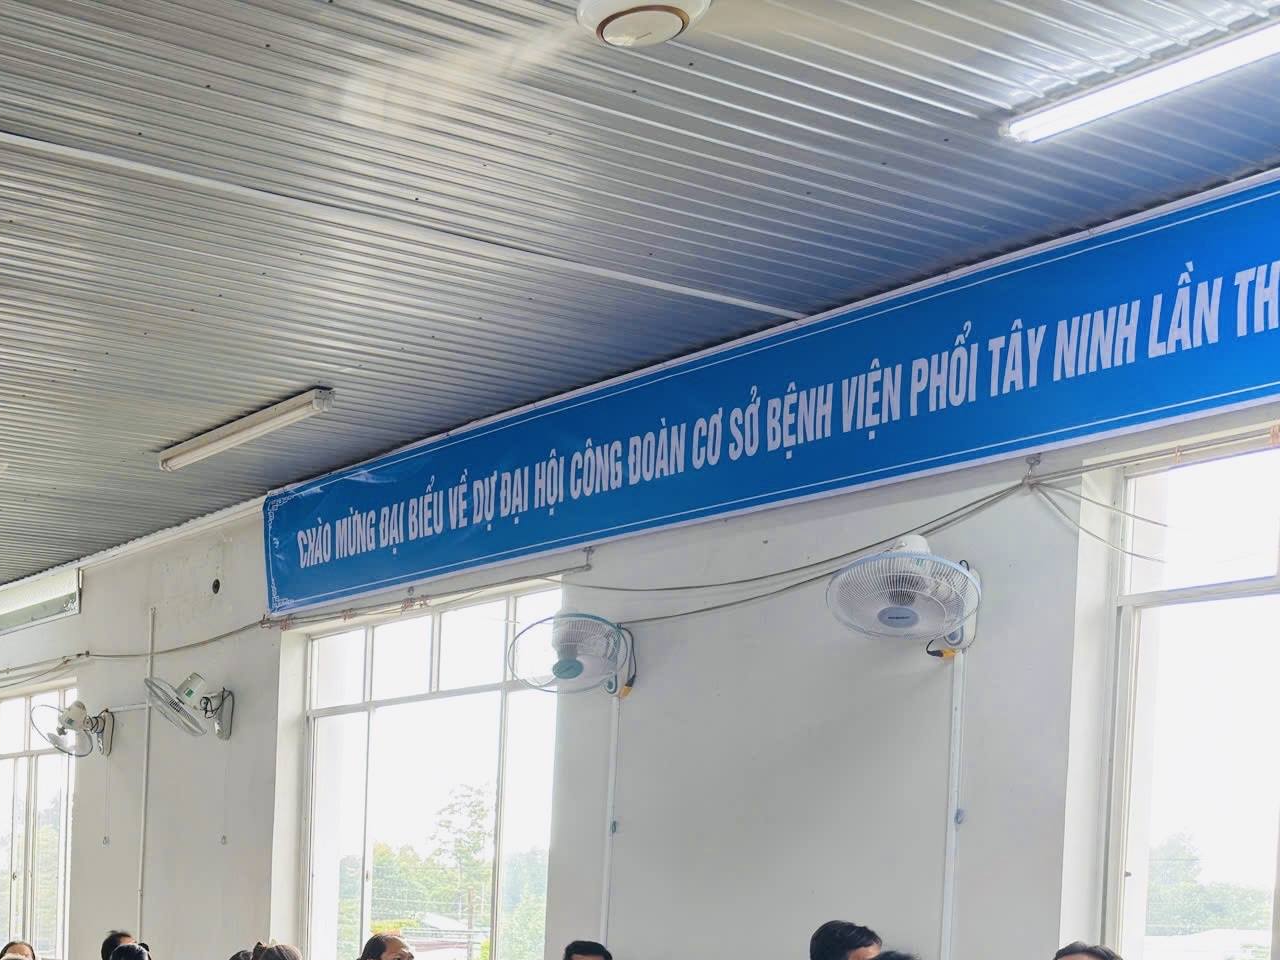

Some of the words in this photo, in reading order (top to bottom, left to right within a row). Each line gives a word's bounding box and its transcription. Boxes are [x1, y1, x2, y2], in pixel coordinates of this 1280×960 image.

[297, 517, 332, 569] CHÀO
[335, 506, 376, 560] MỪNG
[379, 500, 405, 554] ĐẠI
[408, 475, 444, 541] BIỂU
[448, 468, 468, 530] VỀ
[472, 470, 498, 531] DỰ
[499, 468, 529, 524] ĐẠI
[534, 448, 565, 516] HỘI
[570, 438, 622, 500] CÔNG
[628, 417, 686, 486] ĐOÀN
[692, 407, 723, 470] CƠ
[728, 385, 761, 461] SỞ
[767, 381, 834, 460] BỆNH
[841, 358, 903, 440] VIỆN
[910, 320, 979, 417] PHỔI
[988, 318, 1047, 397] TÂY
[1053, 300, 1141, 382] NINH
[1148, 260, 1223, 359] LẦN
